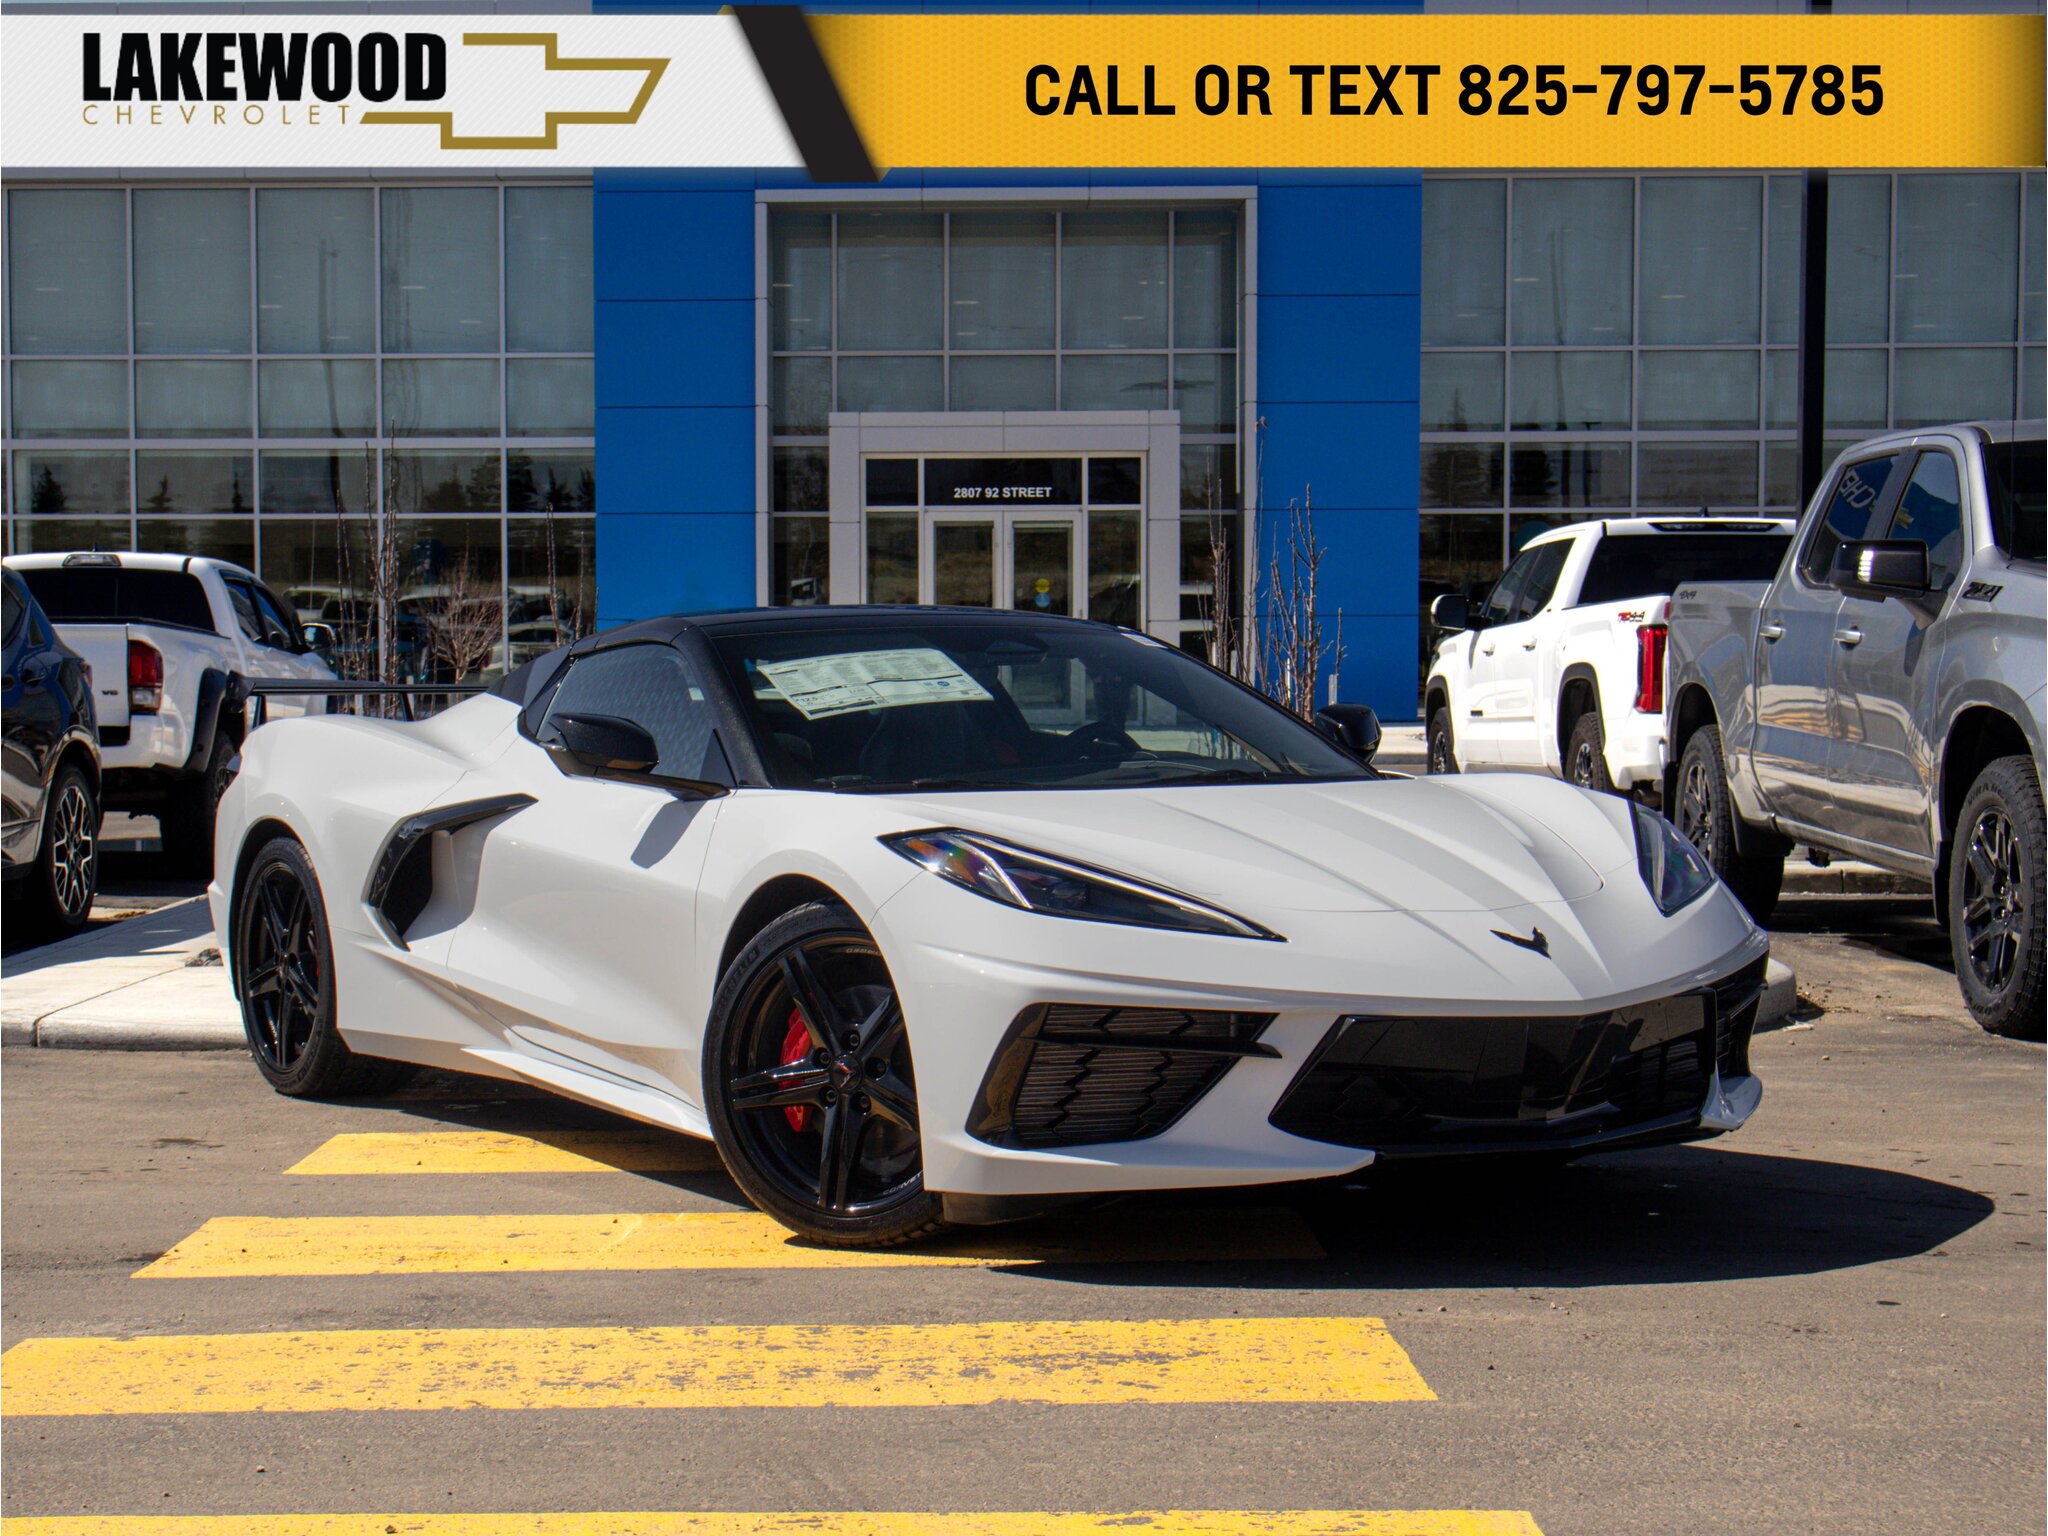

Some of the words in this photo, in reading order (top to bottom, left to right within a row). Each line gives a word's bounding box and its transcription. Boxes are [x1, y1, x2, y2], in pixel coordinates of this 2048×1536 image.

[954, 487, 982, 498] 2807
[984, 487, 1000, 498] 92
[1002, 487, 1053, 498] STREET
